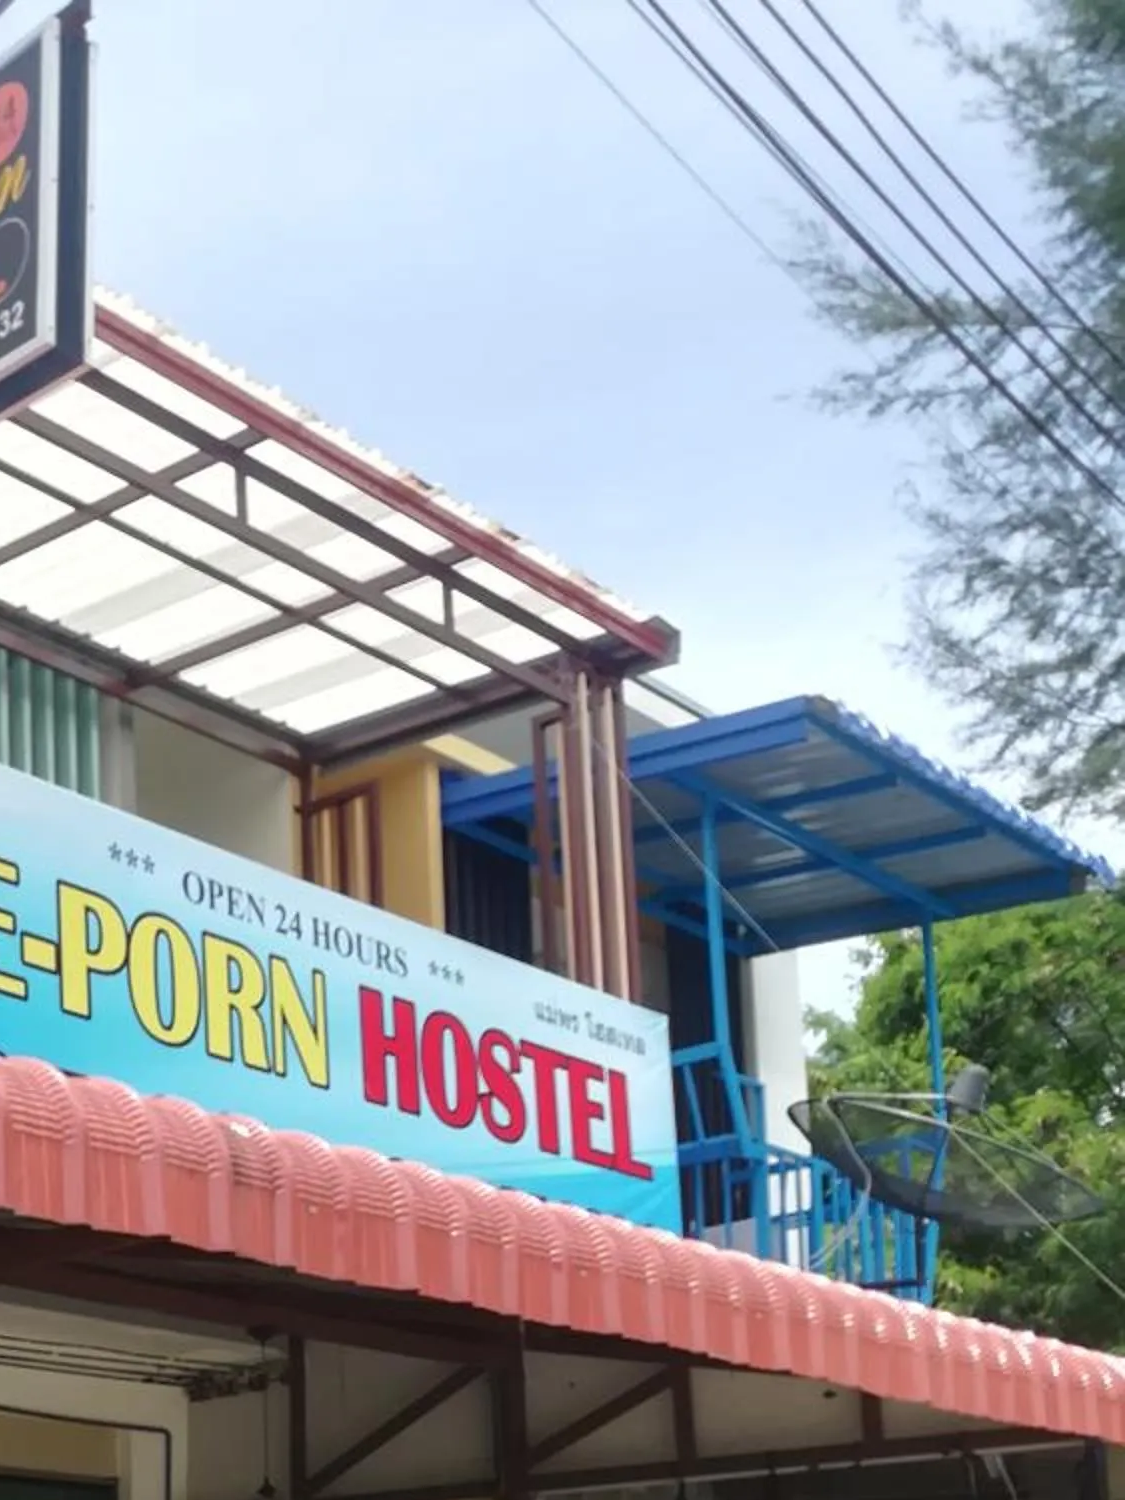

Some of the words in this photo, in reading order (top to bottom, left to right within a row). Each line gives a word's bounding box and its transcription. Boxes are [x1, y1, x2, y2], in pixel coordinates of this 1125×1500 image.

[181, 871, 266, 928] OPEN
[275, 904, 303, 941] 24
[312, 916, 409, 978] HOURS
[358, 984, 655, 1182] HOSTEL
